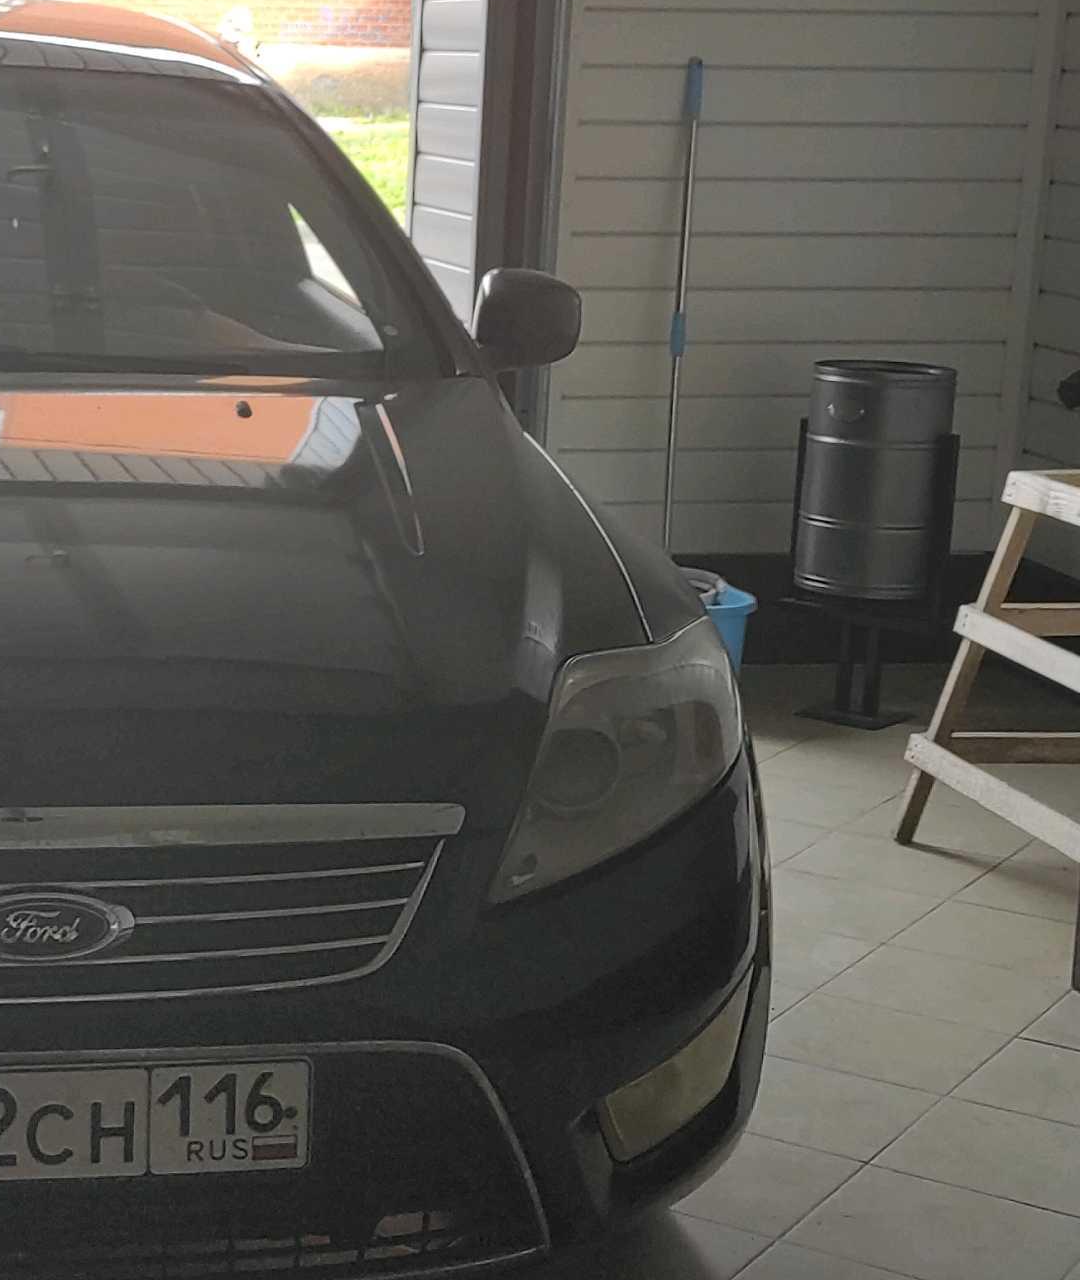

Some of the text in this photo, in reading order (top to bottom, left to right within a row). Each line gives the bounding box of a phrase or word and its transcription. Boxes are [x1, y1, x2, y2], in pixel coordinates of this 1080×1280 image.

[0, 910, 80, 943] Ford
[158, 1071, 283, 1136] 116
[186, 1137, 249, 1163] RUS
